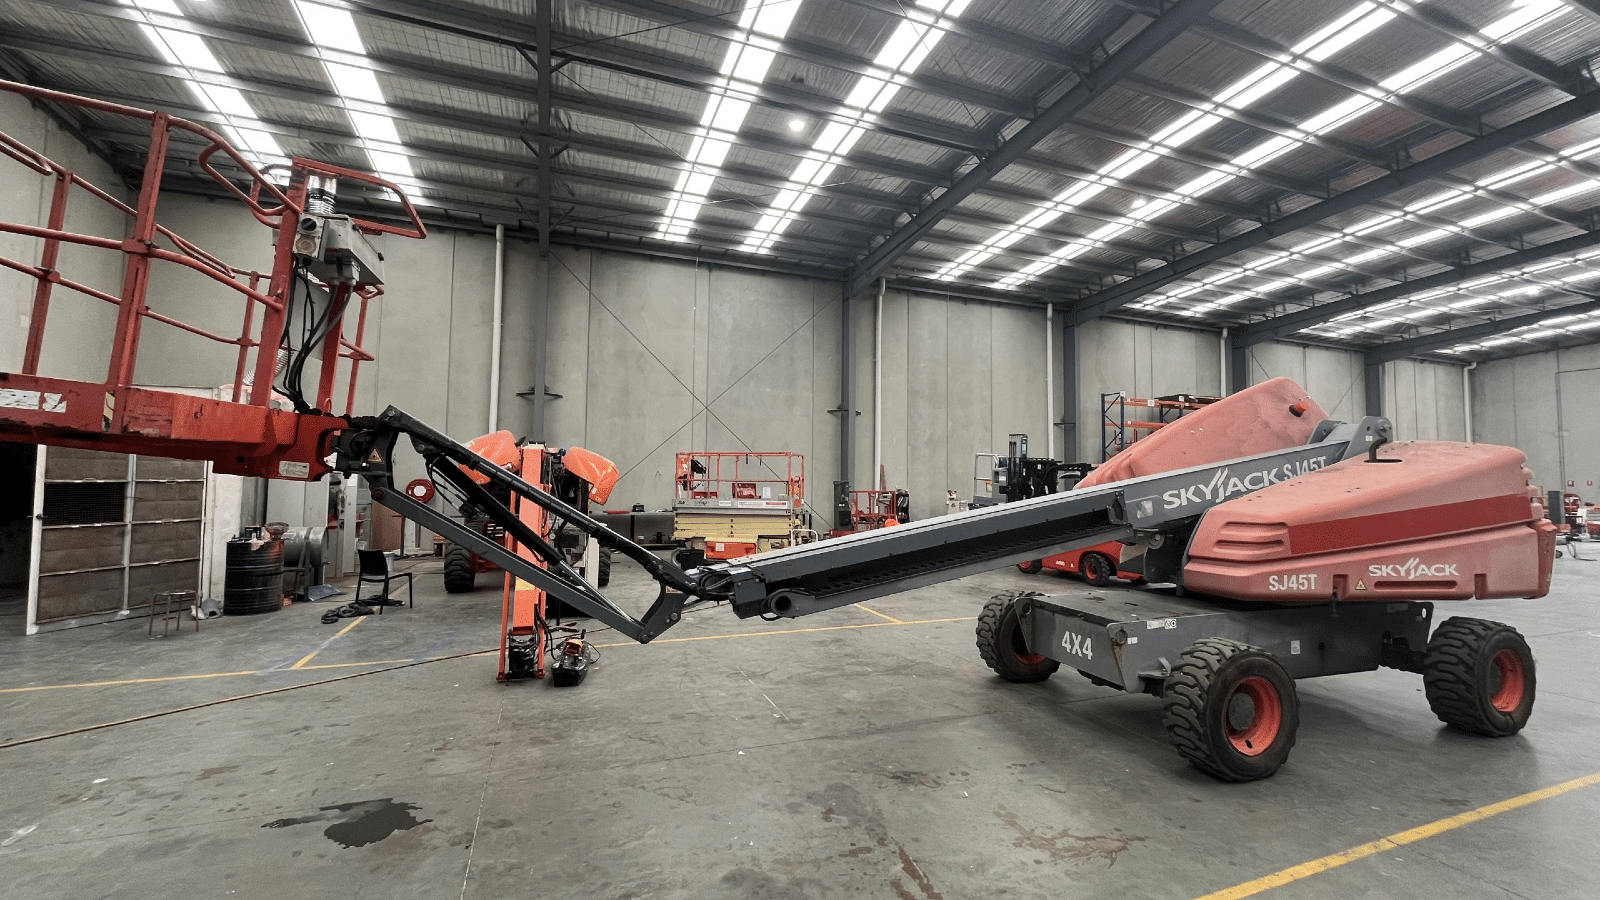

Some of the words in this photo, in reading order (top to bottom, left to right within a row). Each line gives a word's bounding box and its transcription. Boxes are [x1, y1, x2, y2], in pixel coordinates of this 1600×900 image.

[1162, 467, 1280, 509] SKYJACK
[1283, 456, 1327, 481] SJ45T
[1269, 573, 1317, 590] SJ45T
[1368, 557, 1460, 580] SKYJACK
[1061, 630, 1093, 660] 4X4
